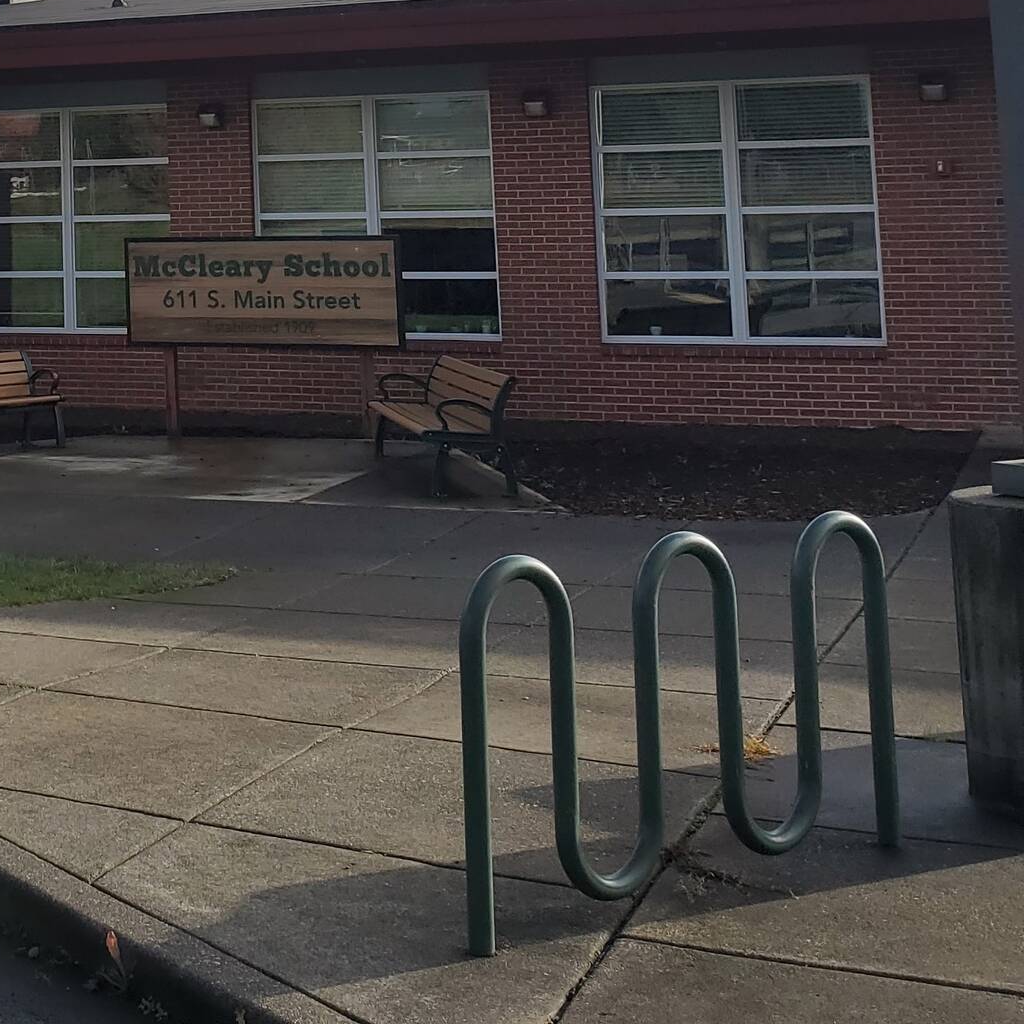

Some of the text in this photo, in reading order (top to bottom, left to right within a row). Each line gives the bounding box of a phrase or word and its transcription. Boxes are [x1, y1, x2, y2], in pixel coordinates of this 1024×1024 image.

[132, 253, 391, 283] McCleary School
[163, 290, 361, 310] 611 S. Main Street
